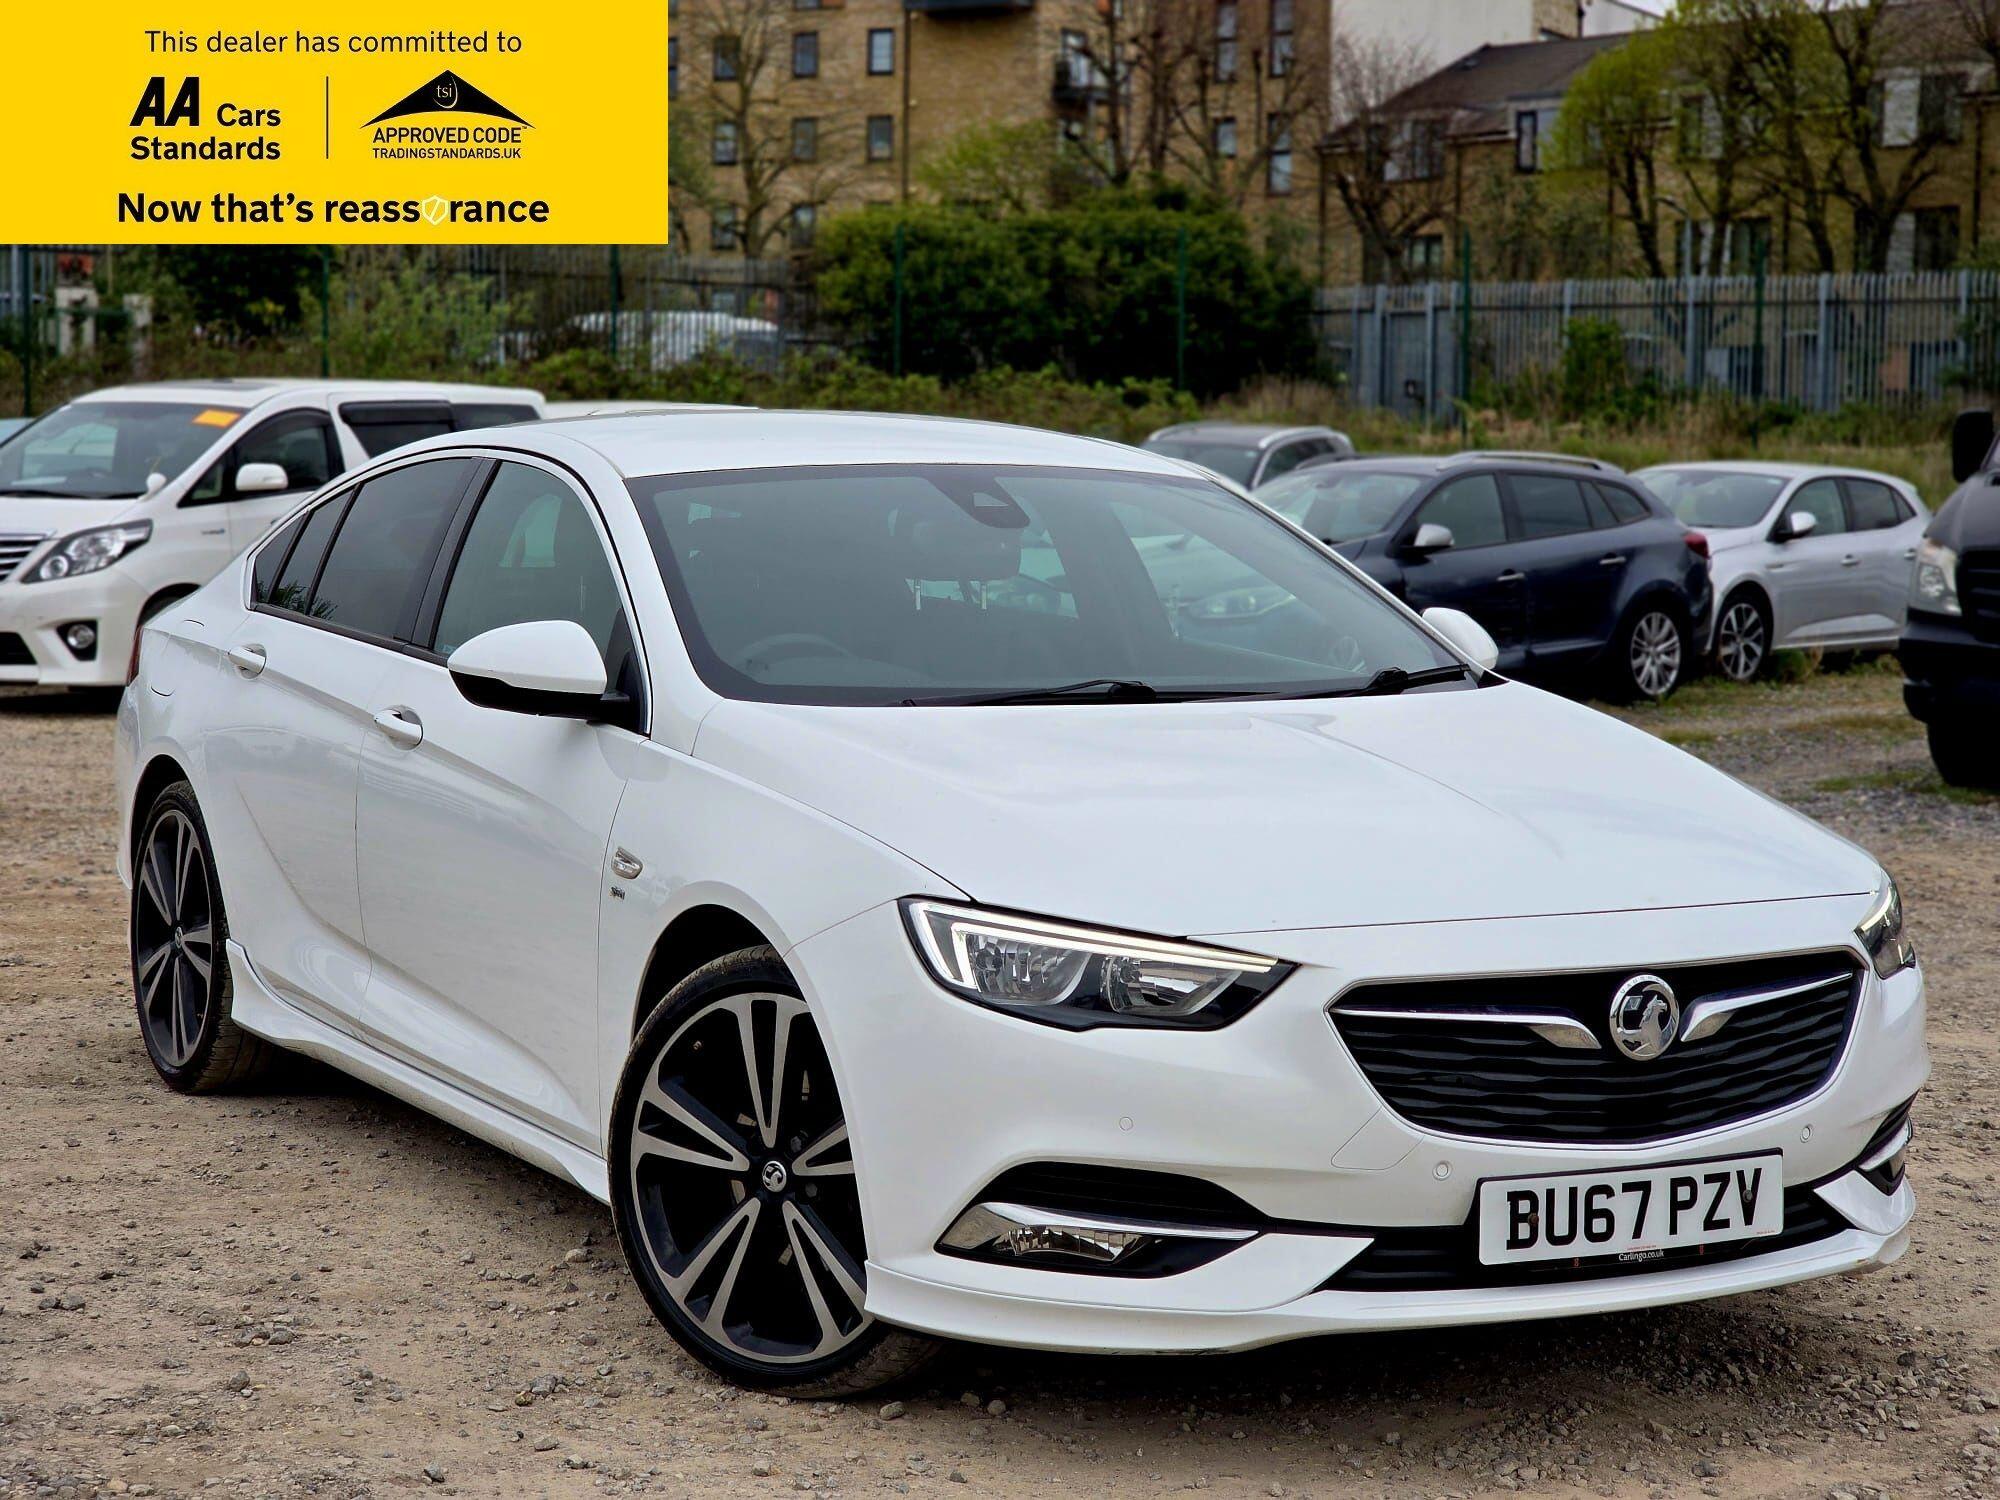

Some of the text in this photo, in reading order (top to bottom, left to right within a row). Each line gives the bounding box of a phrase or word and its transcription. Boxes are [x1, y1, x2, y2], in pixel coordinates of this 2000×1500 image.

[1506, 1167, 1763, 1250] BU67 PZV
[1618, 1249, 1665, 1262] Carlingo.co.uk
